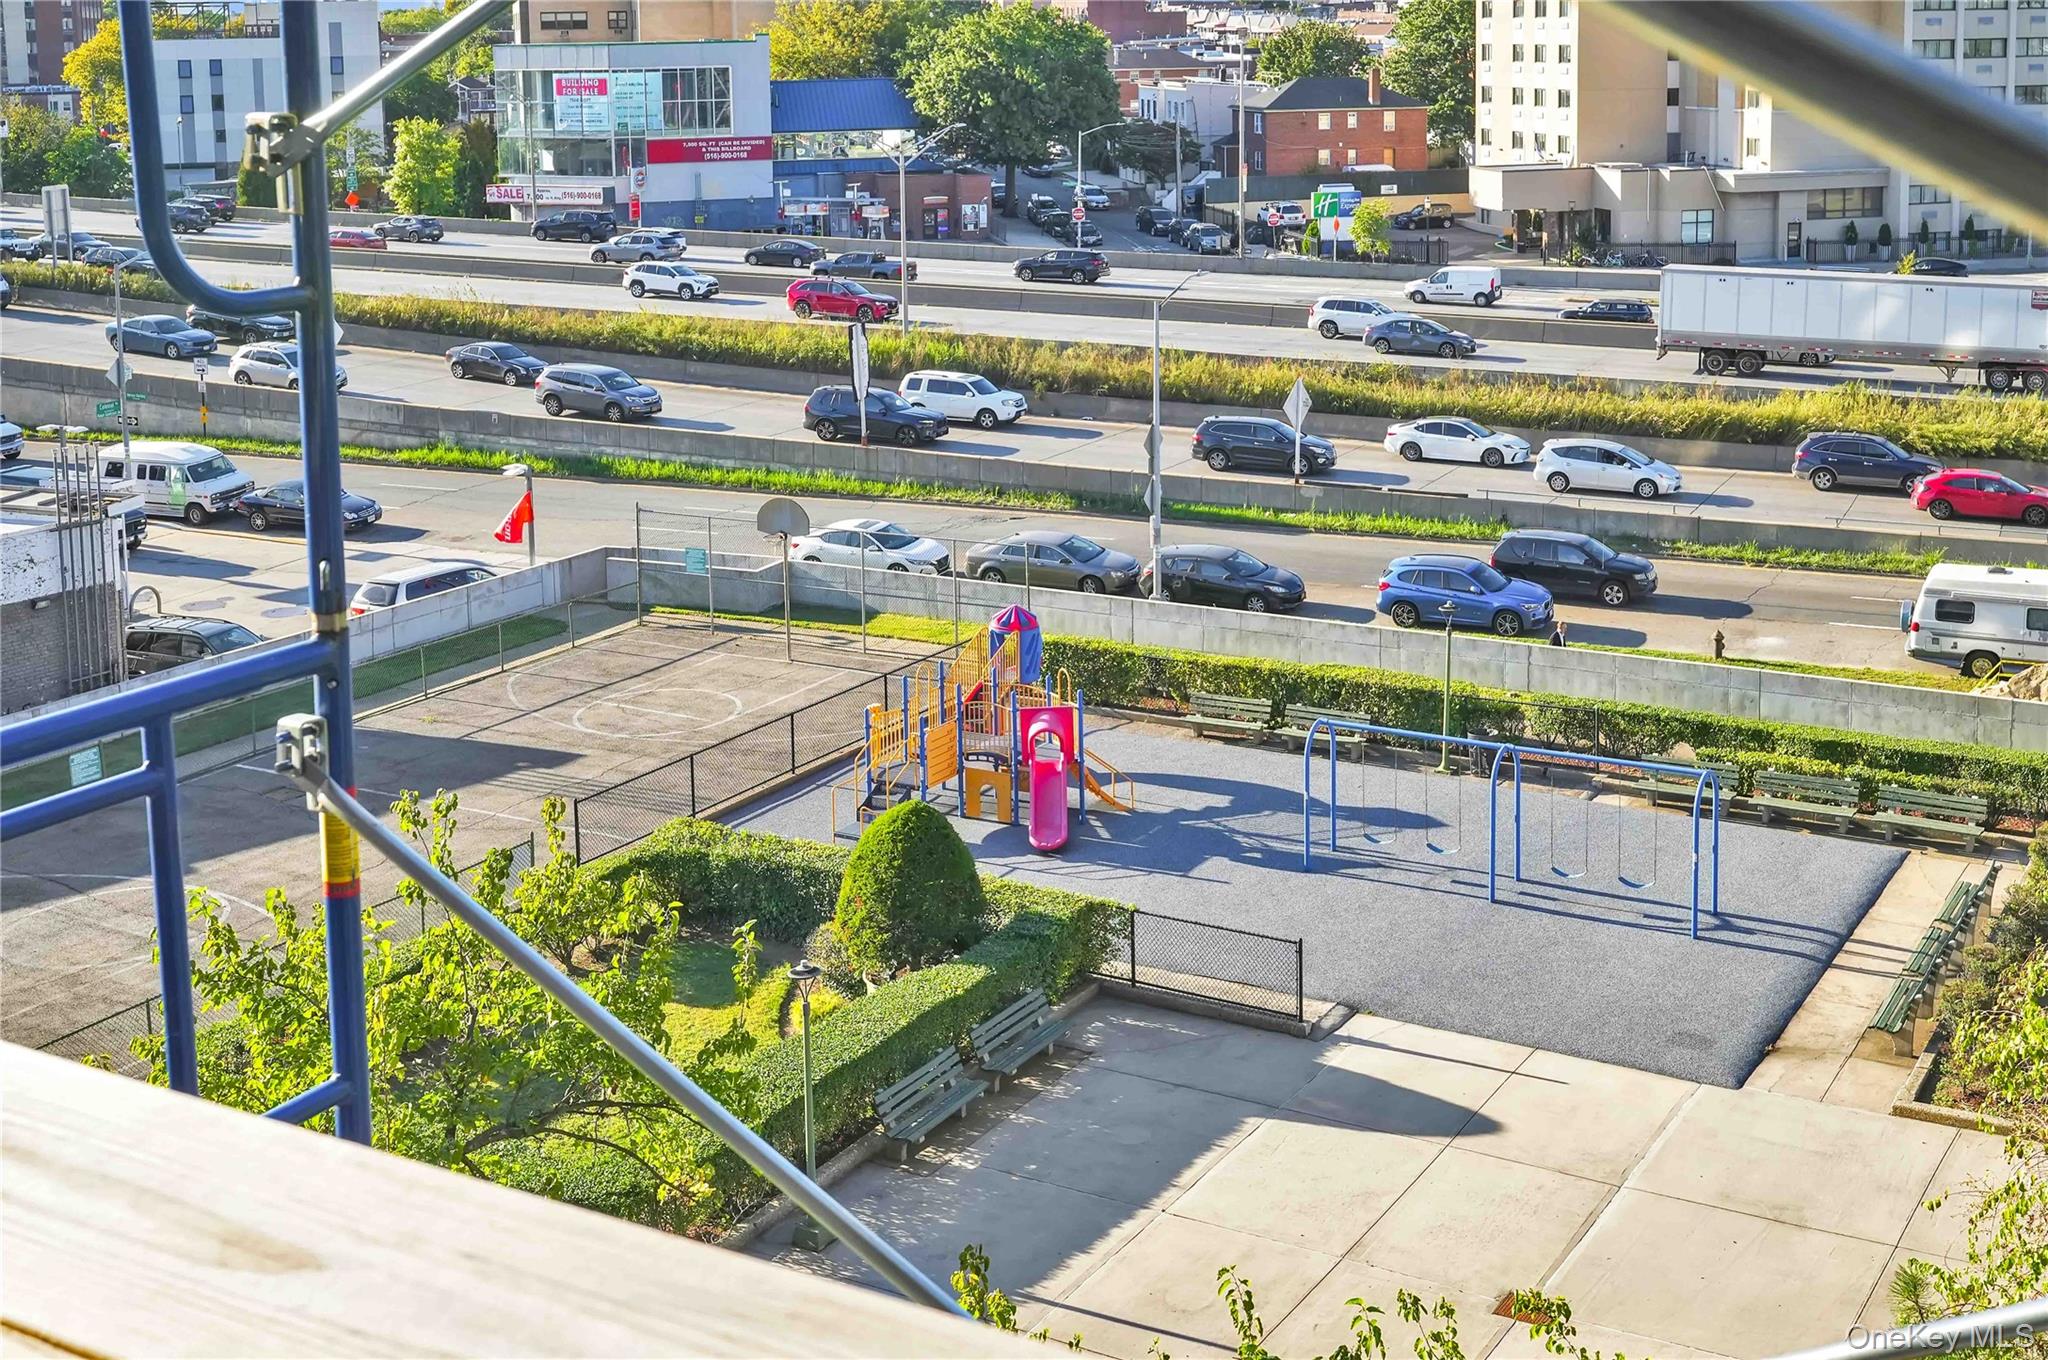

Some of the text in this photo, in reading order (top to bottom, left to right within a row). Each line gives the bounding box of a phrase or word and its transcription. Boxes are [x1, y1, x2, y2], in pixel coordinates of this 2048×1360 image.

[562, 87, 599, 95] FOR SALE
[496, 188, 523, 199] SALE
[561, 191, 601, 200] (516)-900-0168
